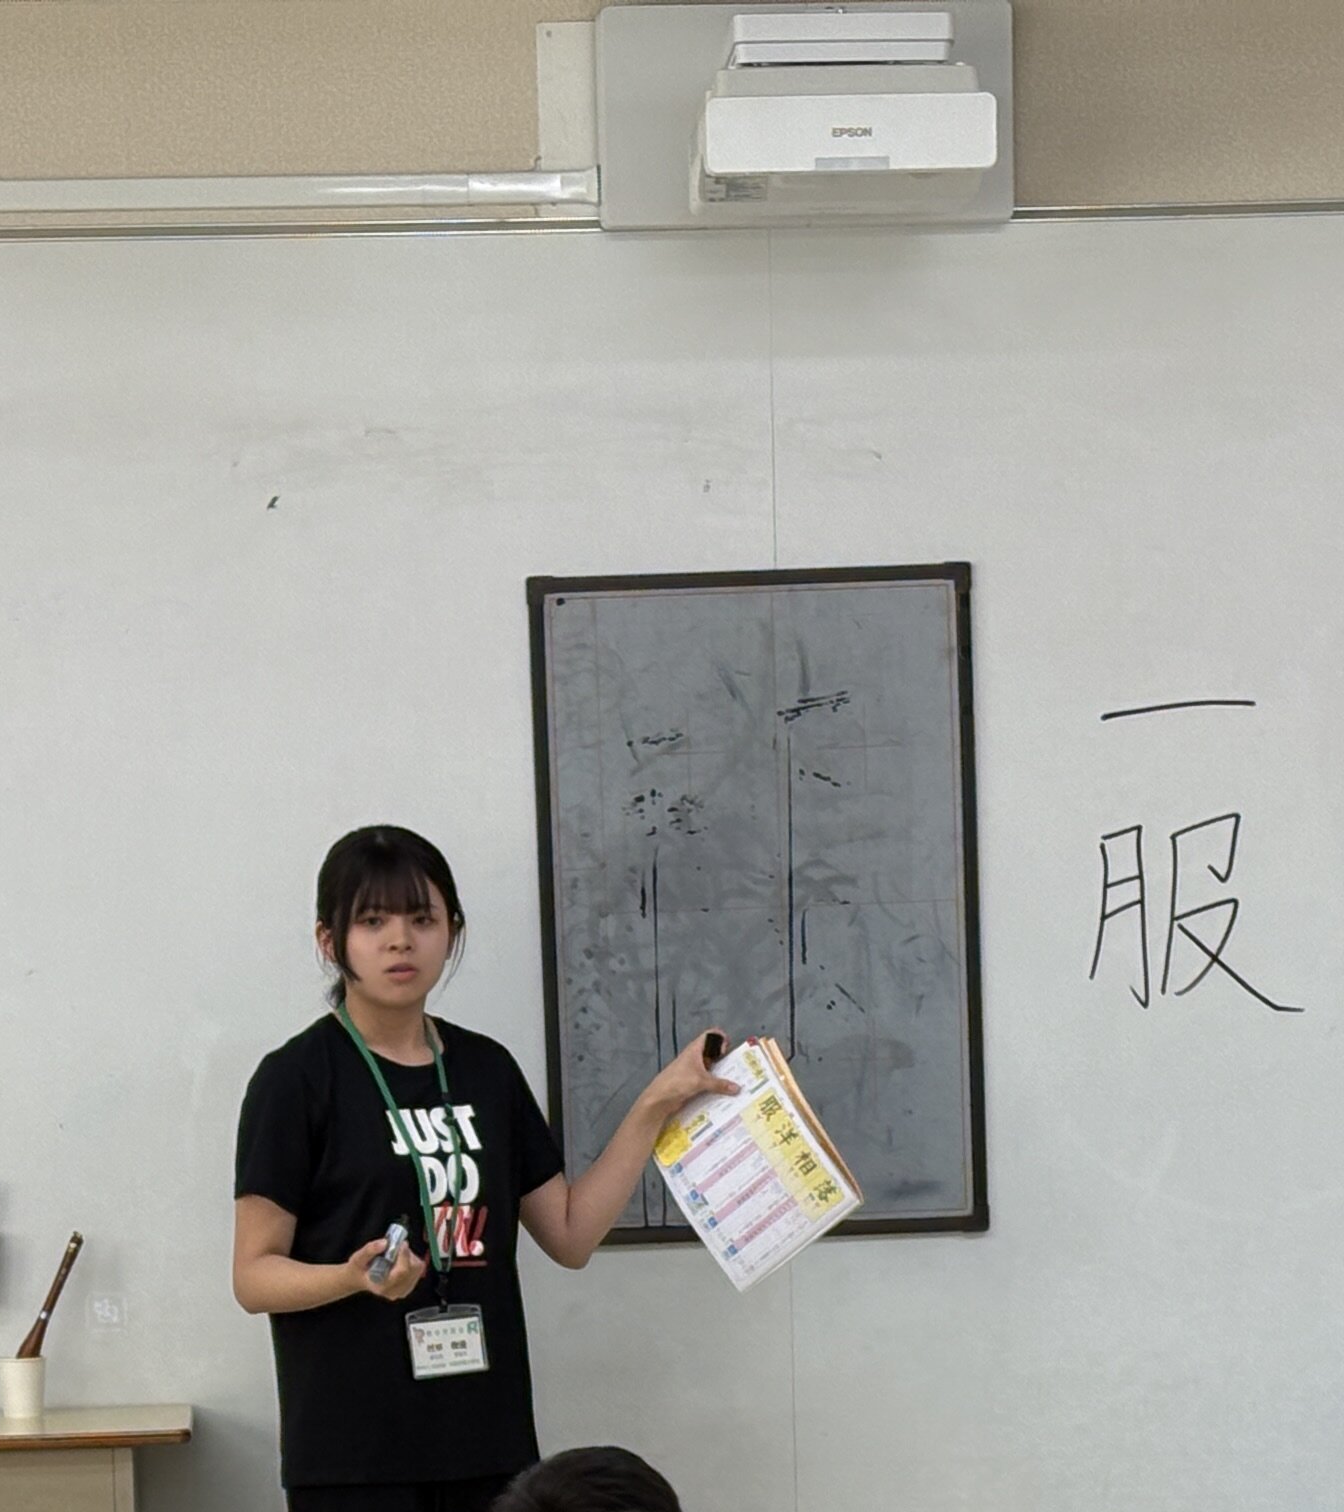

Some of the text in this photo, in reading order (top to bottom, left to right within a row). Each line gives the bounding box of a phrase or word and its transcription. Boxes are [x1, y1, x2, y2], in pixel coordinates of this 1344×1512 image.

[831, 127, 873, 138] EPSON
[758, 1093, 782, 1122] 服
[385, 1103, 484, 1156] JUST
[419, 1152, 481, 1206] DO
